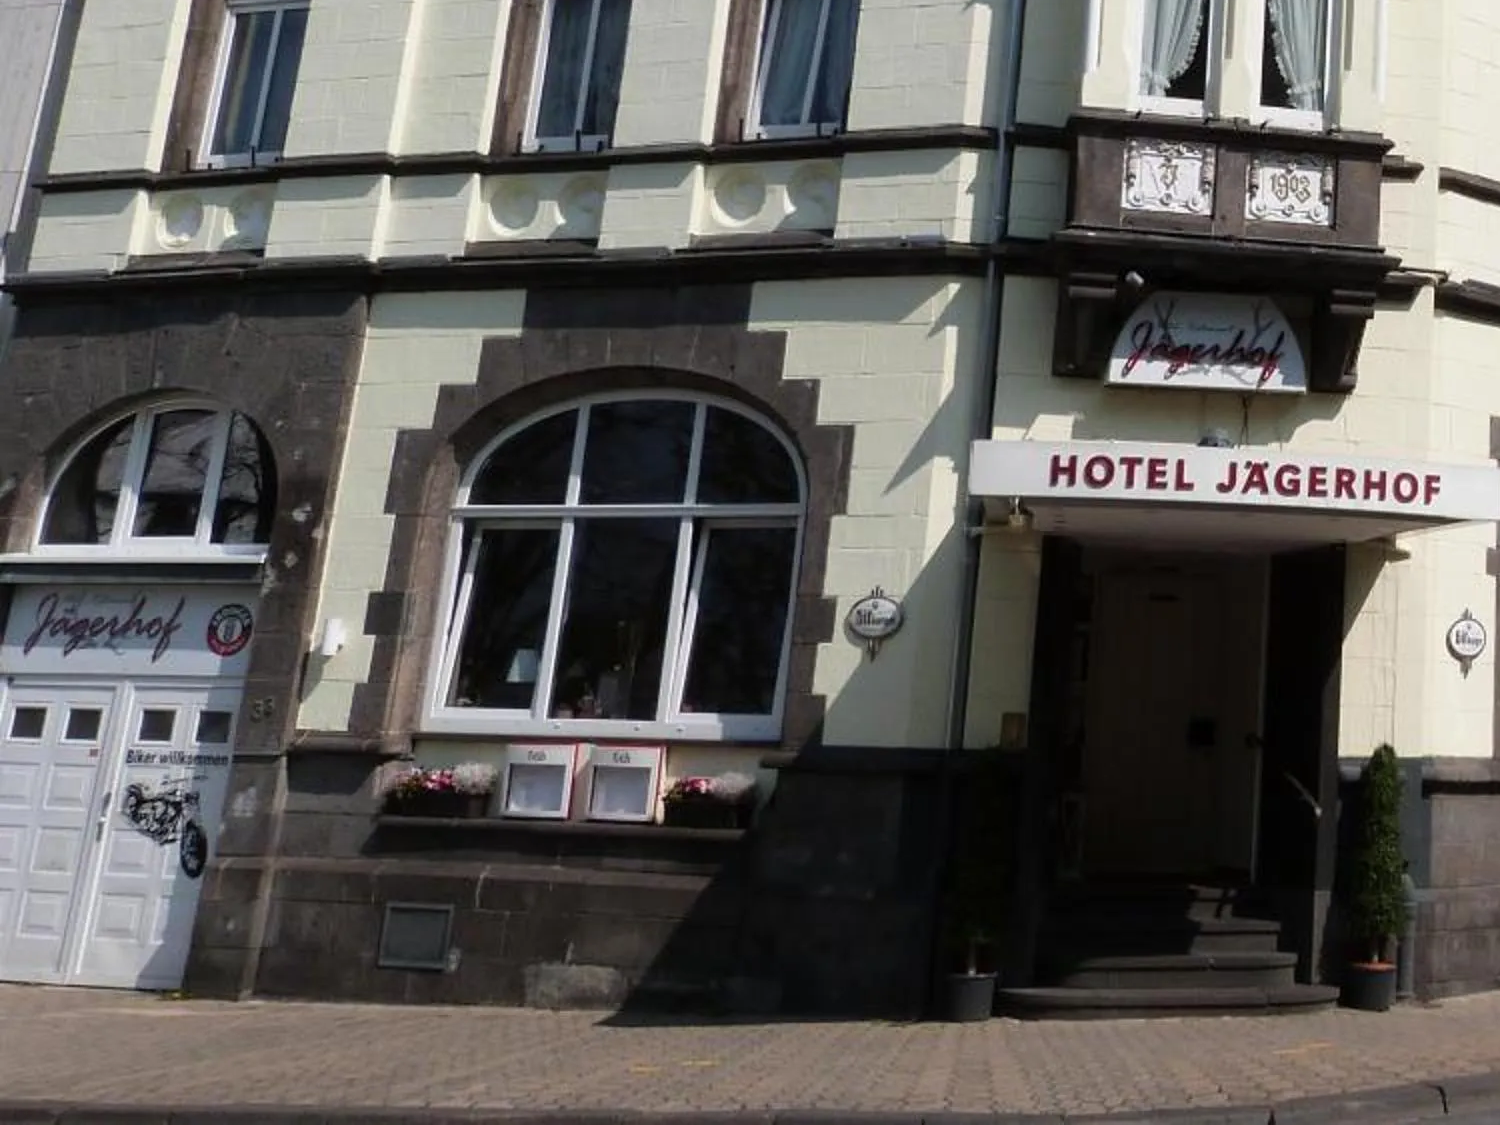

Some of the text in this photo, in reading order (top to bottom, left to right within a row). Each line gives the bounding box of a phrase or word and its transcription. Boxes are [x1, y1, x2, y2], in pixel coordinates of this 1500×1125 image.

[1270, 173, 1310, 203] 1903
[1122, 321, 1284, 387] Jägerhof
[1048, 454, 1441, 504] HOTEL JÄGERHOF
[24, 592, 185, 663] Jägerhof
[126, 749, 157, 764] Biker
